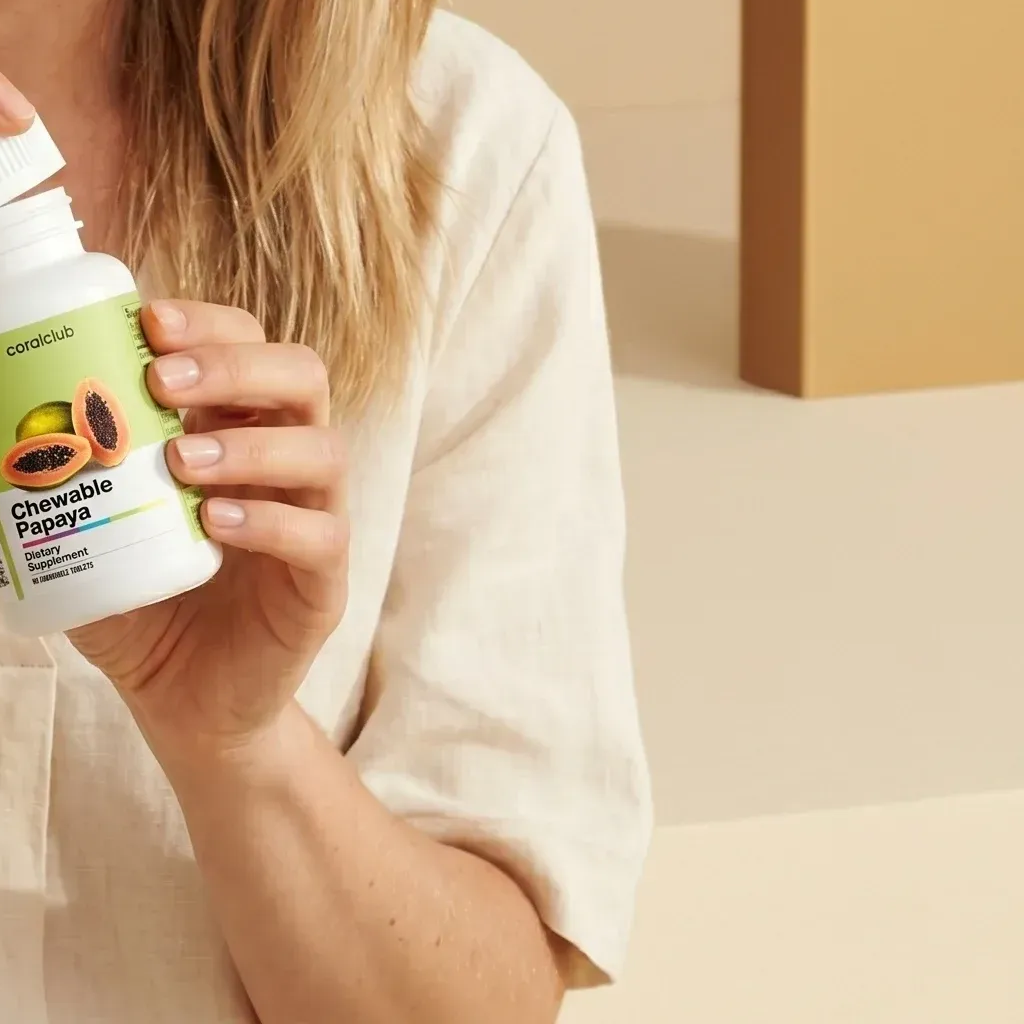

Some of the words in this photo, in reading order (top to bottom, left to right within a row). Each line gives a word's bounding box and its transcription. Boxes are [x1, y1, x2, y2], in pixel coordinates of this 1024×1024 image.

[6, 325, 74, 356] coralclub
[11, 479, 113, 520] Chewable
[16, 506, 91, 538] Papaya
[24, 545, 61, 561] Dietary
[27, 547, 89, 572] Supplement
